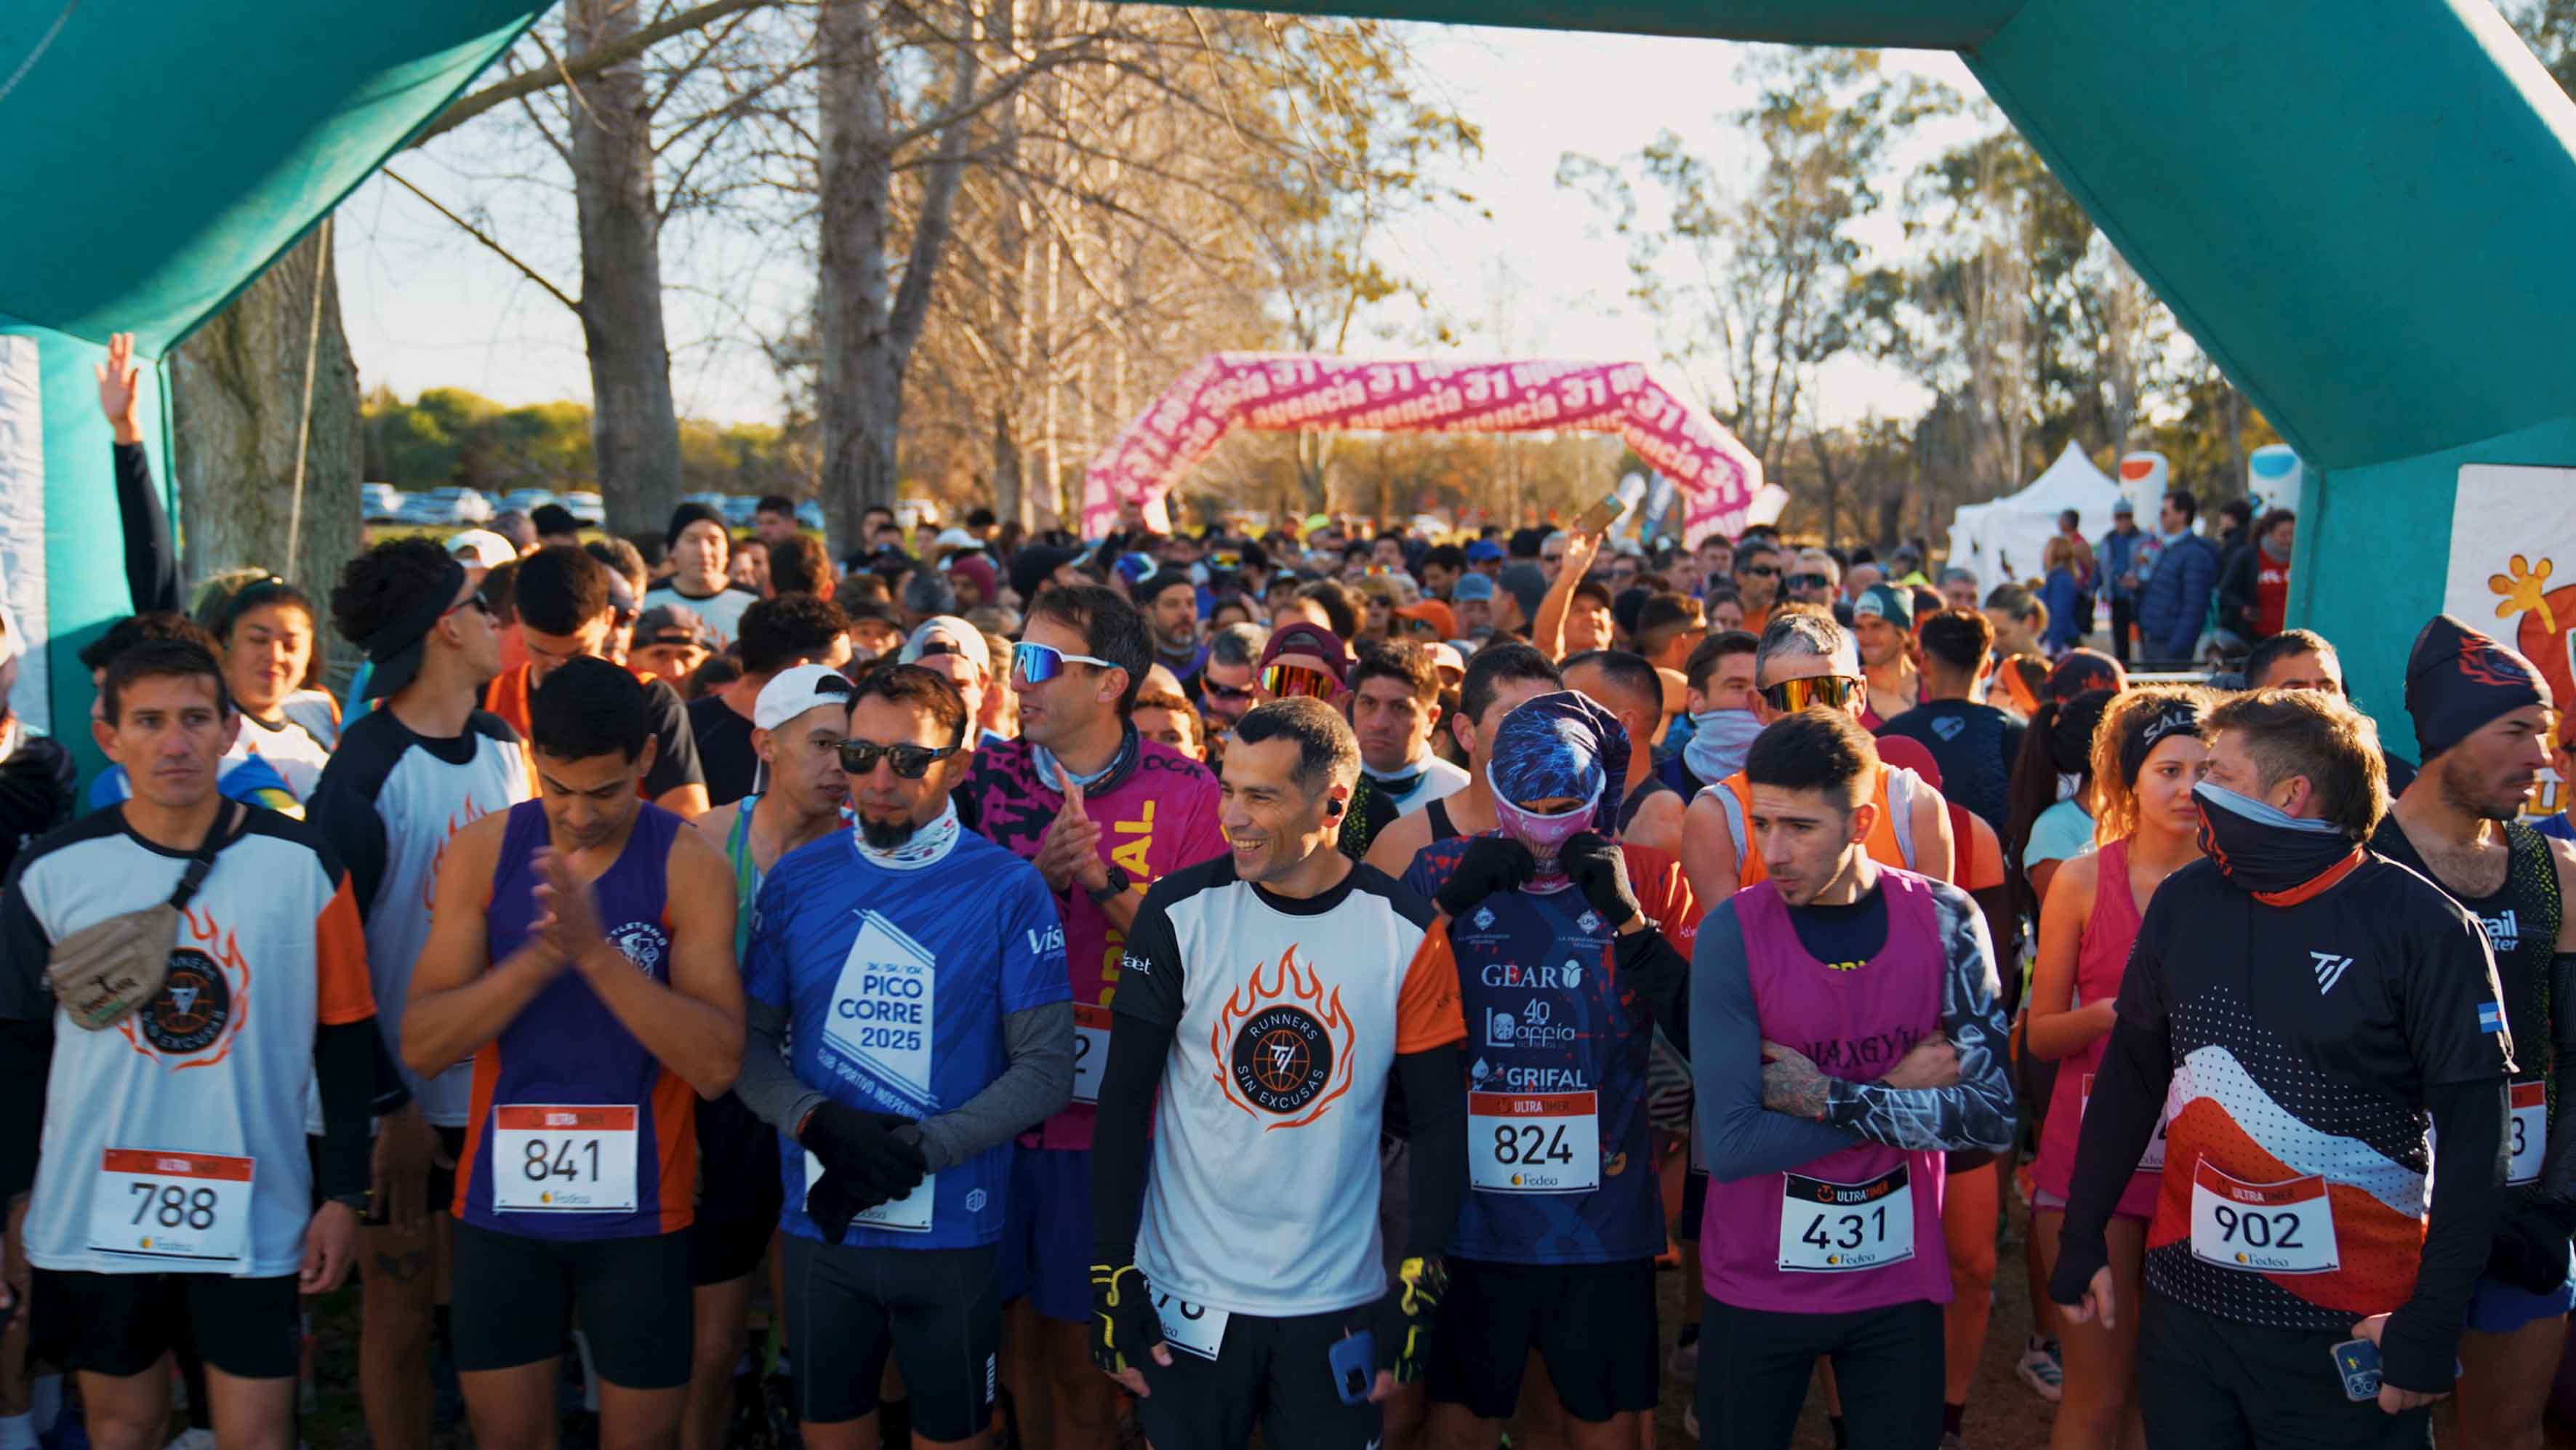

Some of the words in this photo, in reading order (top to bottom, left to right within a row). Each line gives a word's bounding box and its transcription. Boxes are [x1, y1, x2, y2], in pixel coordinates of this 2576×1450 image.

[1462, 369, 1509, 401] 31
[1560, 375, 1607, 407] 31
[862, 974, 923, 999] PICO
[1480, 964, 1560, 990] GEAR
[838, 998, 923, 1025] CORRE
[1249, 1014, 1318, 1041] RUNNERS
[860, 1027, 921, 1052] 2025
[1237, 1065, 1257, 1094] SIN
[1258, 1068, 1325, 1109] EXCUSAS
[1506, 1067, 1588, 1088] GRIFAL
[523, 1138, 600, 1182] 841
[1494, 1123, 1573, 1165] 824
[129, 1182, 217, 1230] 788
[1802, 1204, 1885, 1250] 431
[2214, 1205, 2304, 1249] 902
